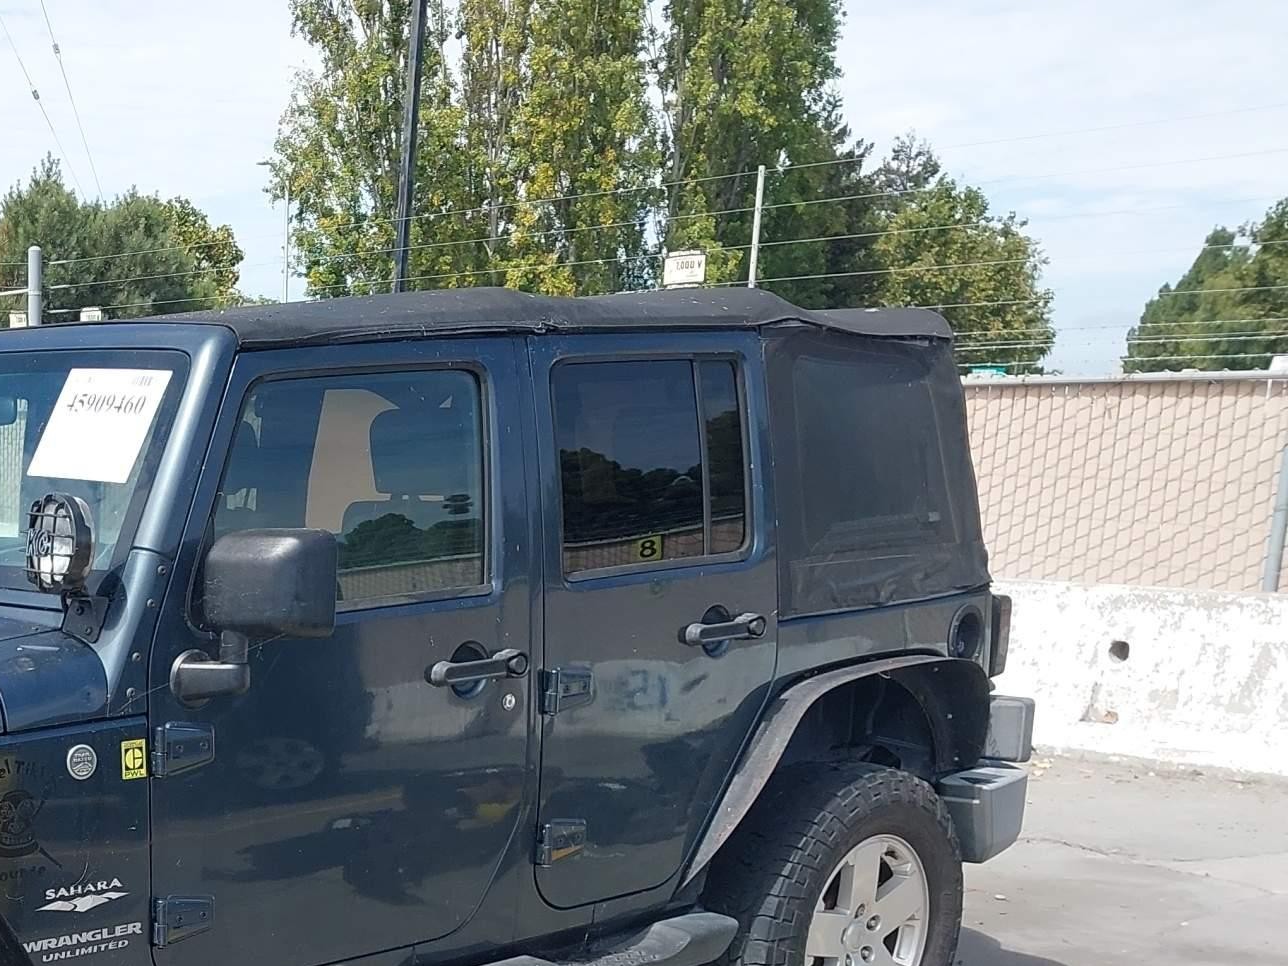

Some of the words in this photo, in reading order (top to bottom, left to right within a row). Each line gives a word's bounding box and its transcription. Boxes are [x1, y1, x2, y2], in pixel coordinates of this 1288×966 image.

[639, 540, 657, 558] 8
[45, 878, 123, 900] SAHARA
[23, 922, 144, 953] WRANGLER
[42, 940, 129, 963] UNLIMITED
